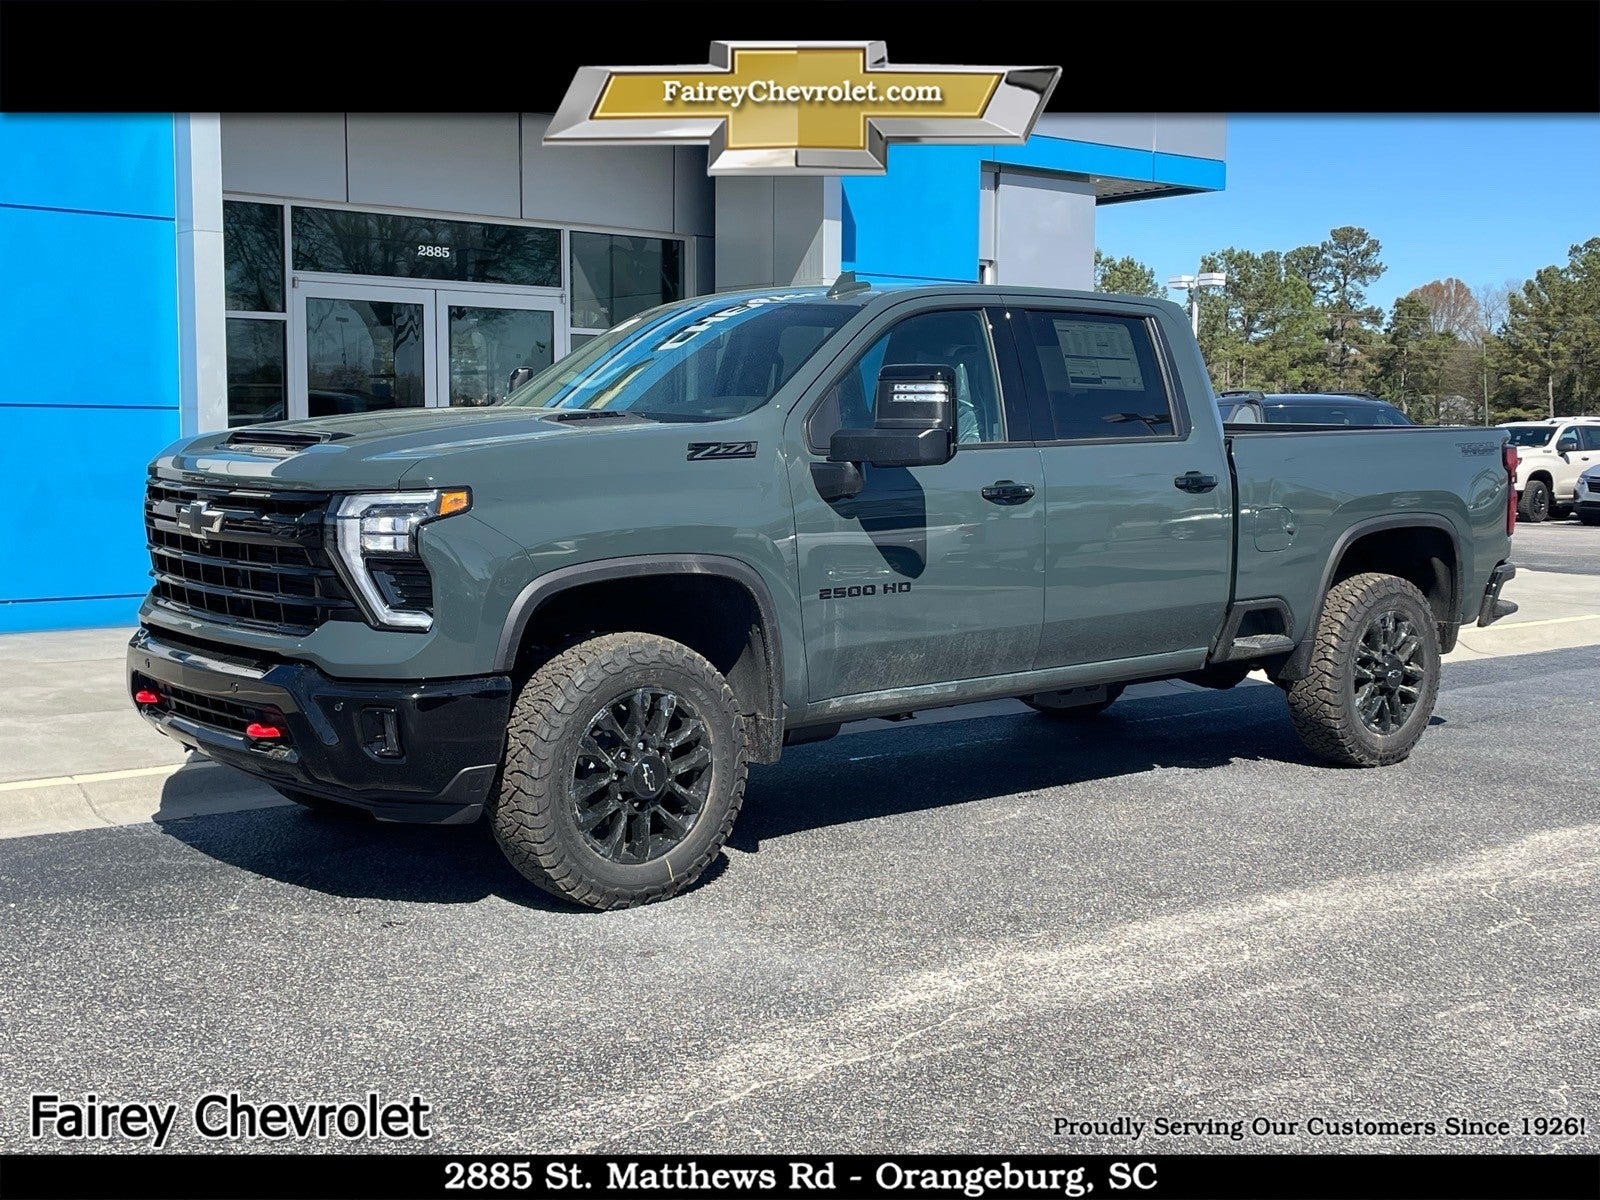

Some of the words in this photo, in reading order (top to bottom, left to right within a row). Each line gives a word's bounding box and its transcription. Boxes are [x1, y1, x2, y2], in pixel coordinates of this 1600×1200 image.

[417, 244, 450, 258] 2885
[687, 441, 758, 461] Z71
[819, 584, 876, 599] 2500
[883, 582, 911, 594] HD
